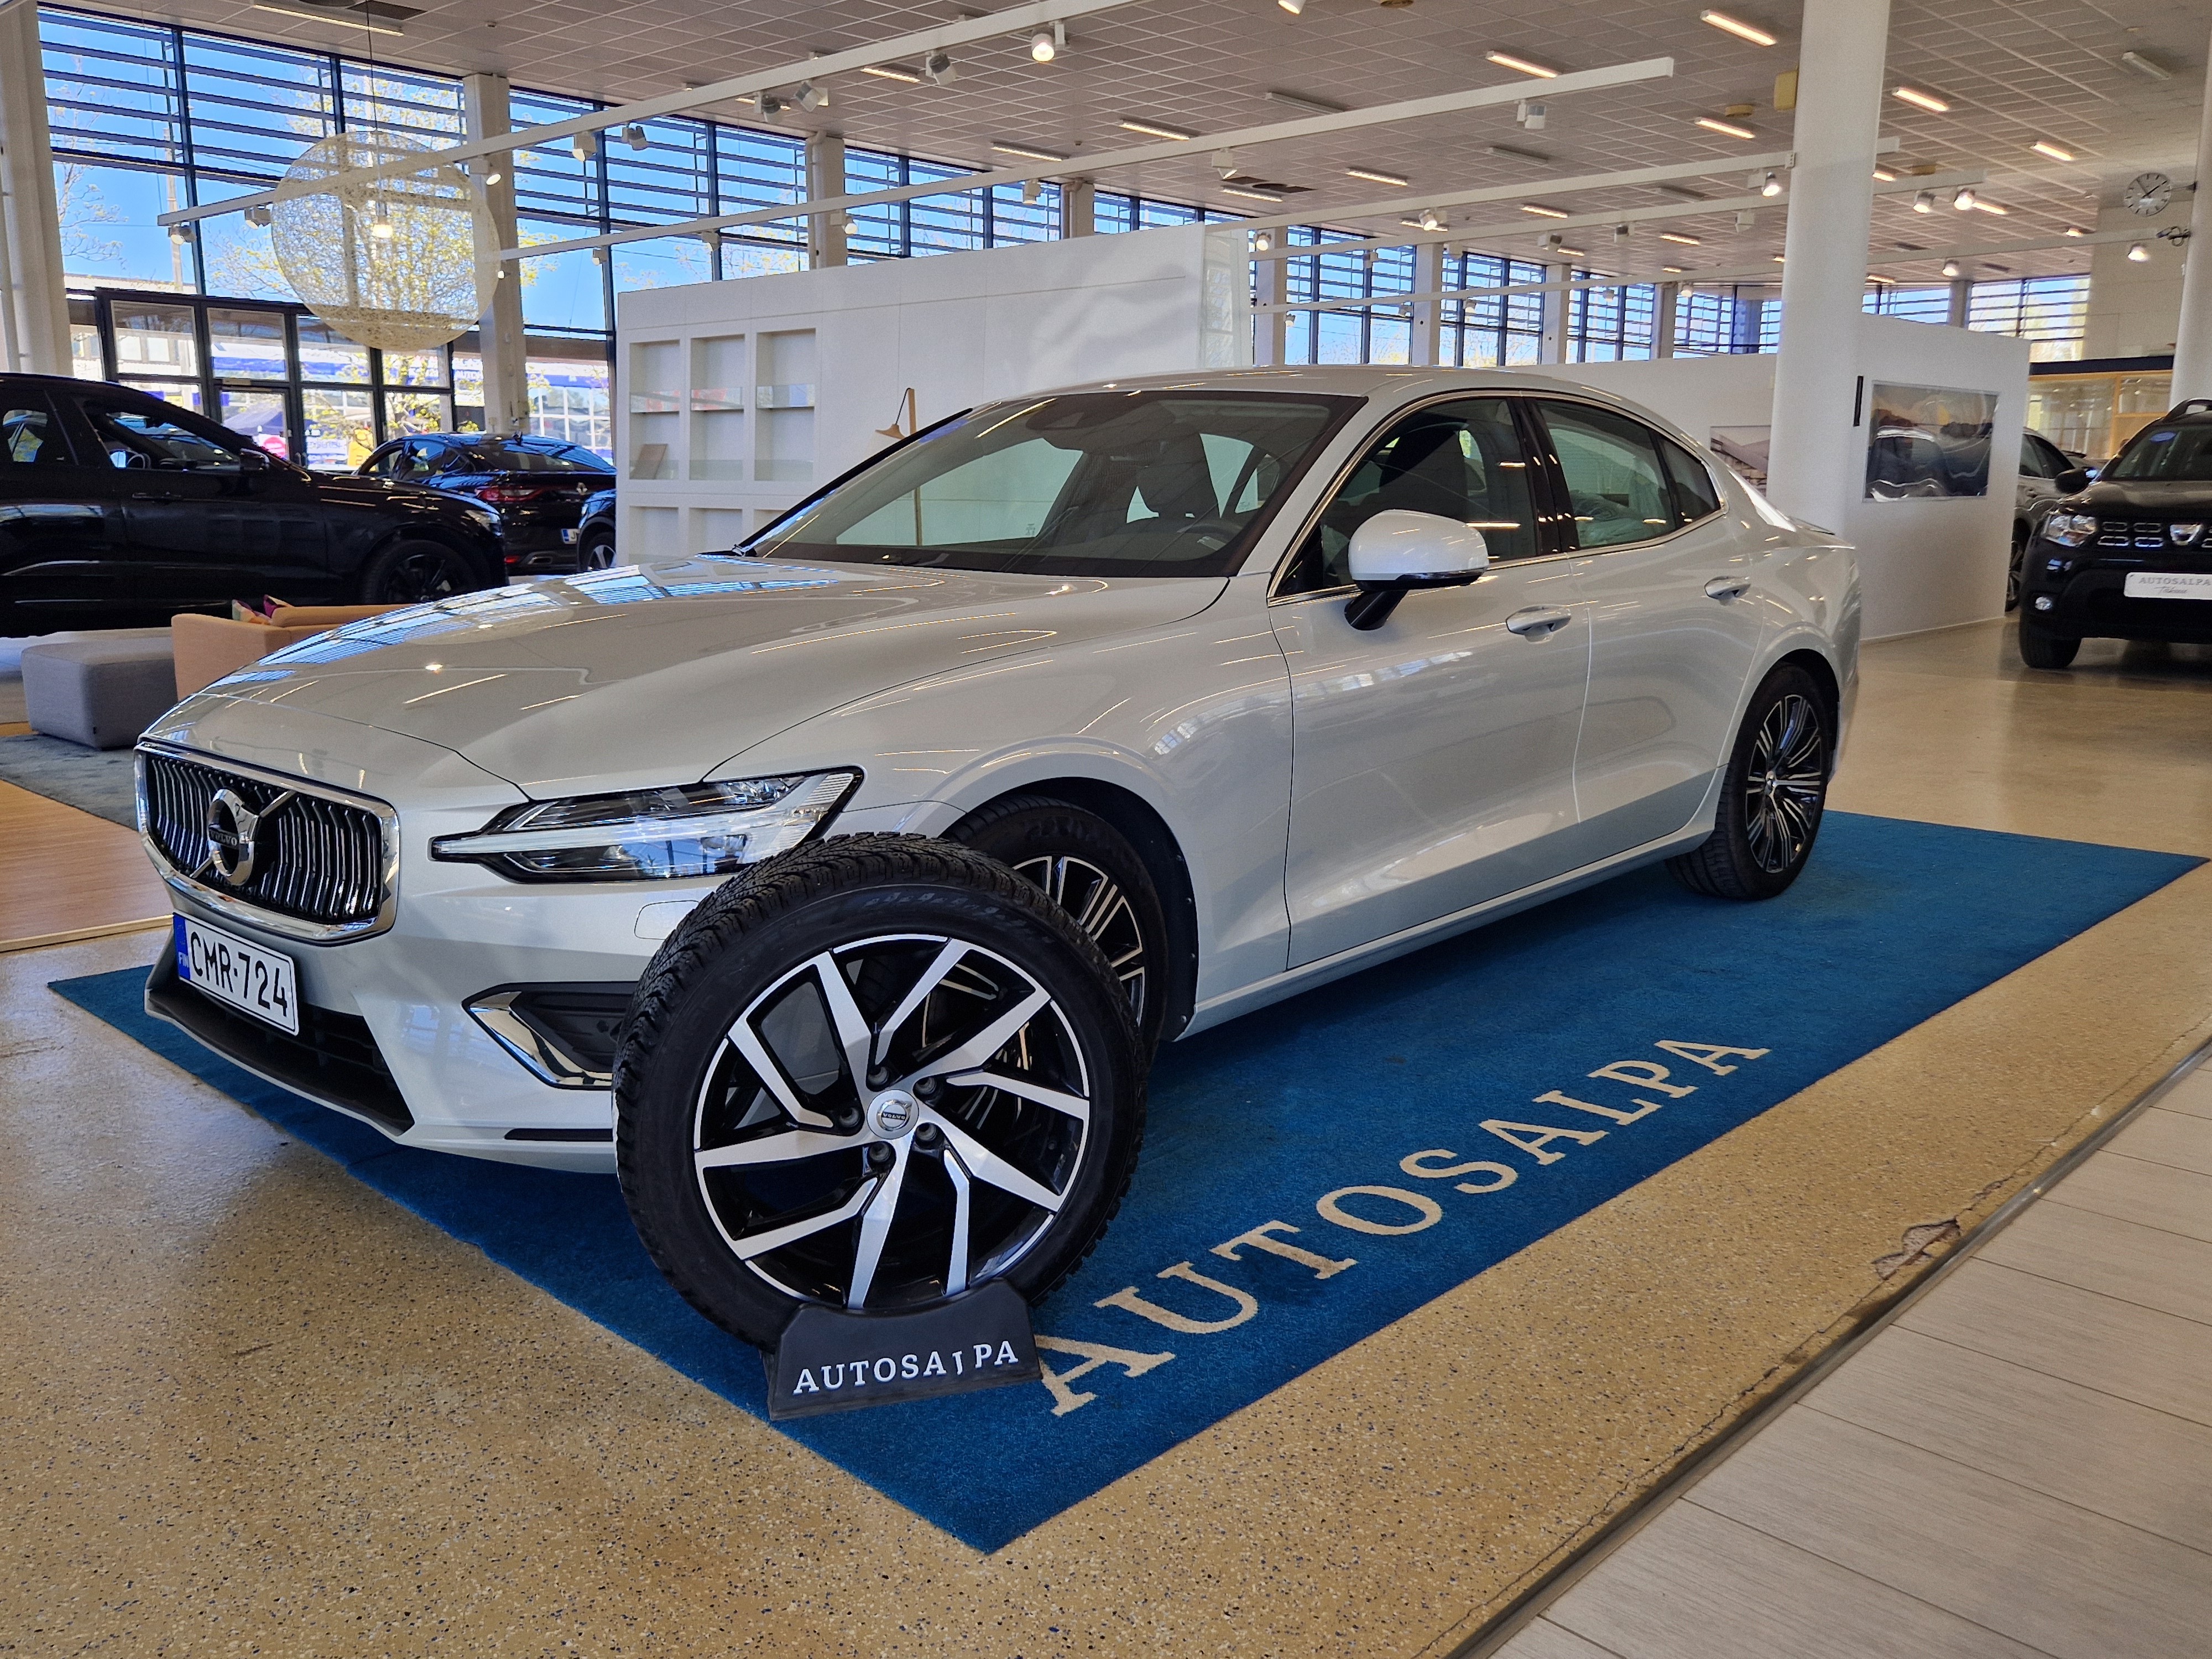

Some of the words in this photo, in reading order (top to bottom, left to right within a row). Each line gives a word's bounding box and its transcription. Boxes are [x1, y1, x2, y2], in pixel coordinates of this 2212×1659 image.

[2138, 577, 2211, 586] AUTOSALPA
[210, 830, 238, 846] VOLVO
[178, 951, 190, 968] FIN
[191, 931, 288, 1018] CMR-724
[1034, 1040, 1771, 1417] AUTOSALPA
